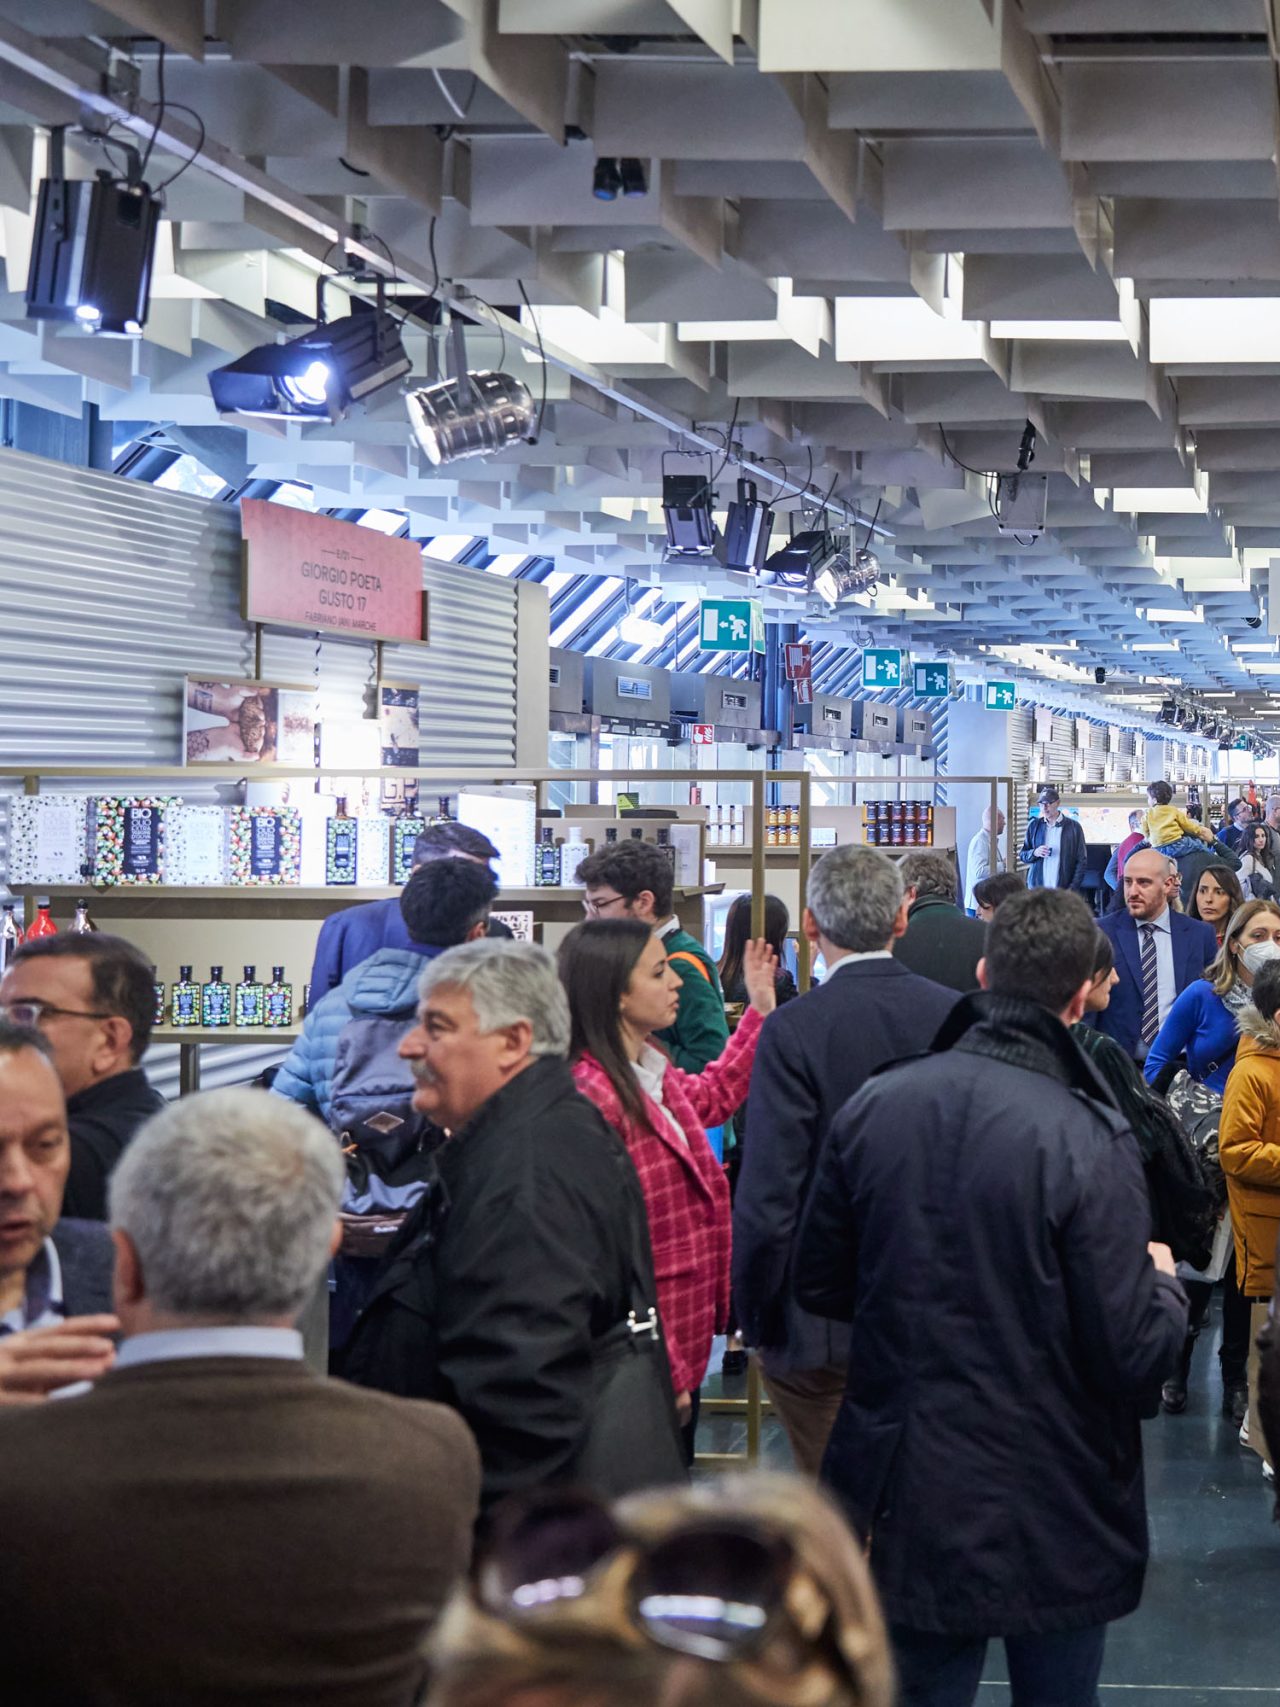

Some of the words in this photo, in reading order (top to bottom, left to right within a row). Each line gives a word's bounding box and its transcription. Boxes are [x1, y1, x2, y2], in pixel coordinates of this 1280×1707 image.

[302, 561, 348, 585] GIORGIO
[350, 570, 382, 592] POETA
[319, 588, 355, 610] GUSTO
[357, 596, 367, 612] 17
[131, 808, 152, 819] BIO
[256, 817, 275, 828] BIO
